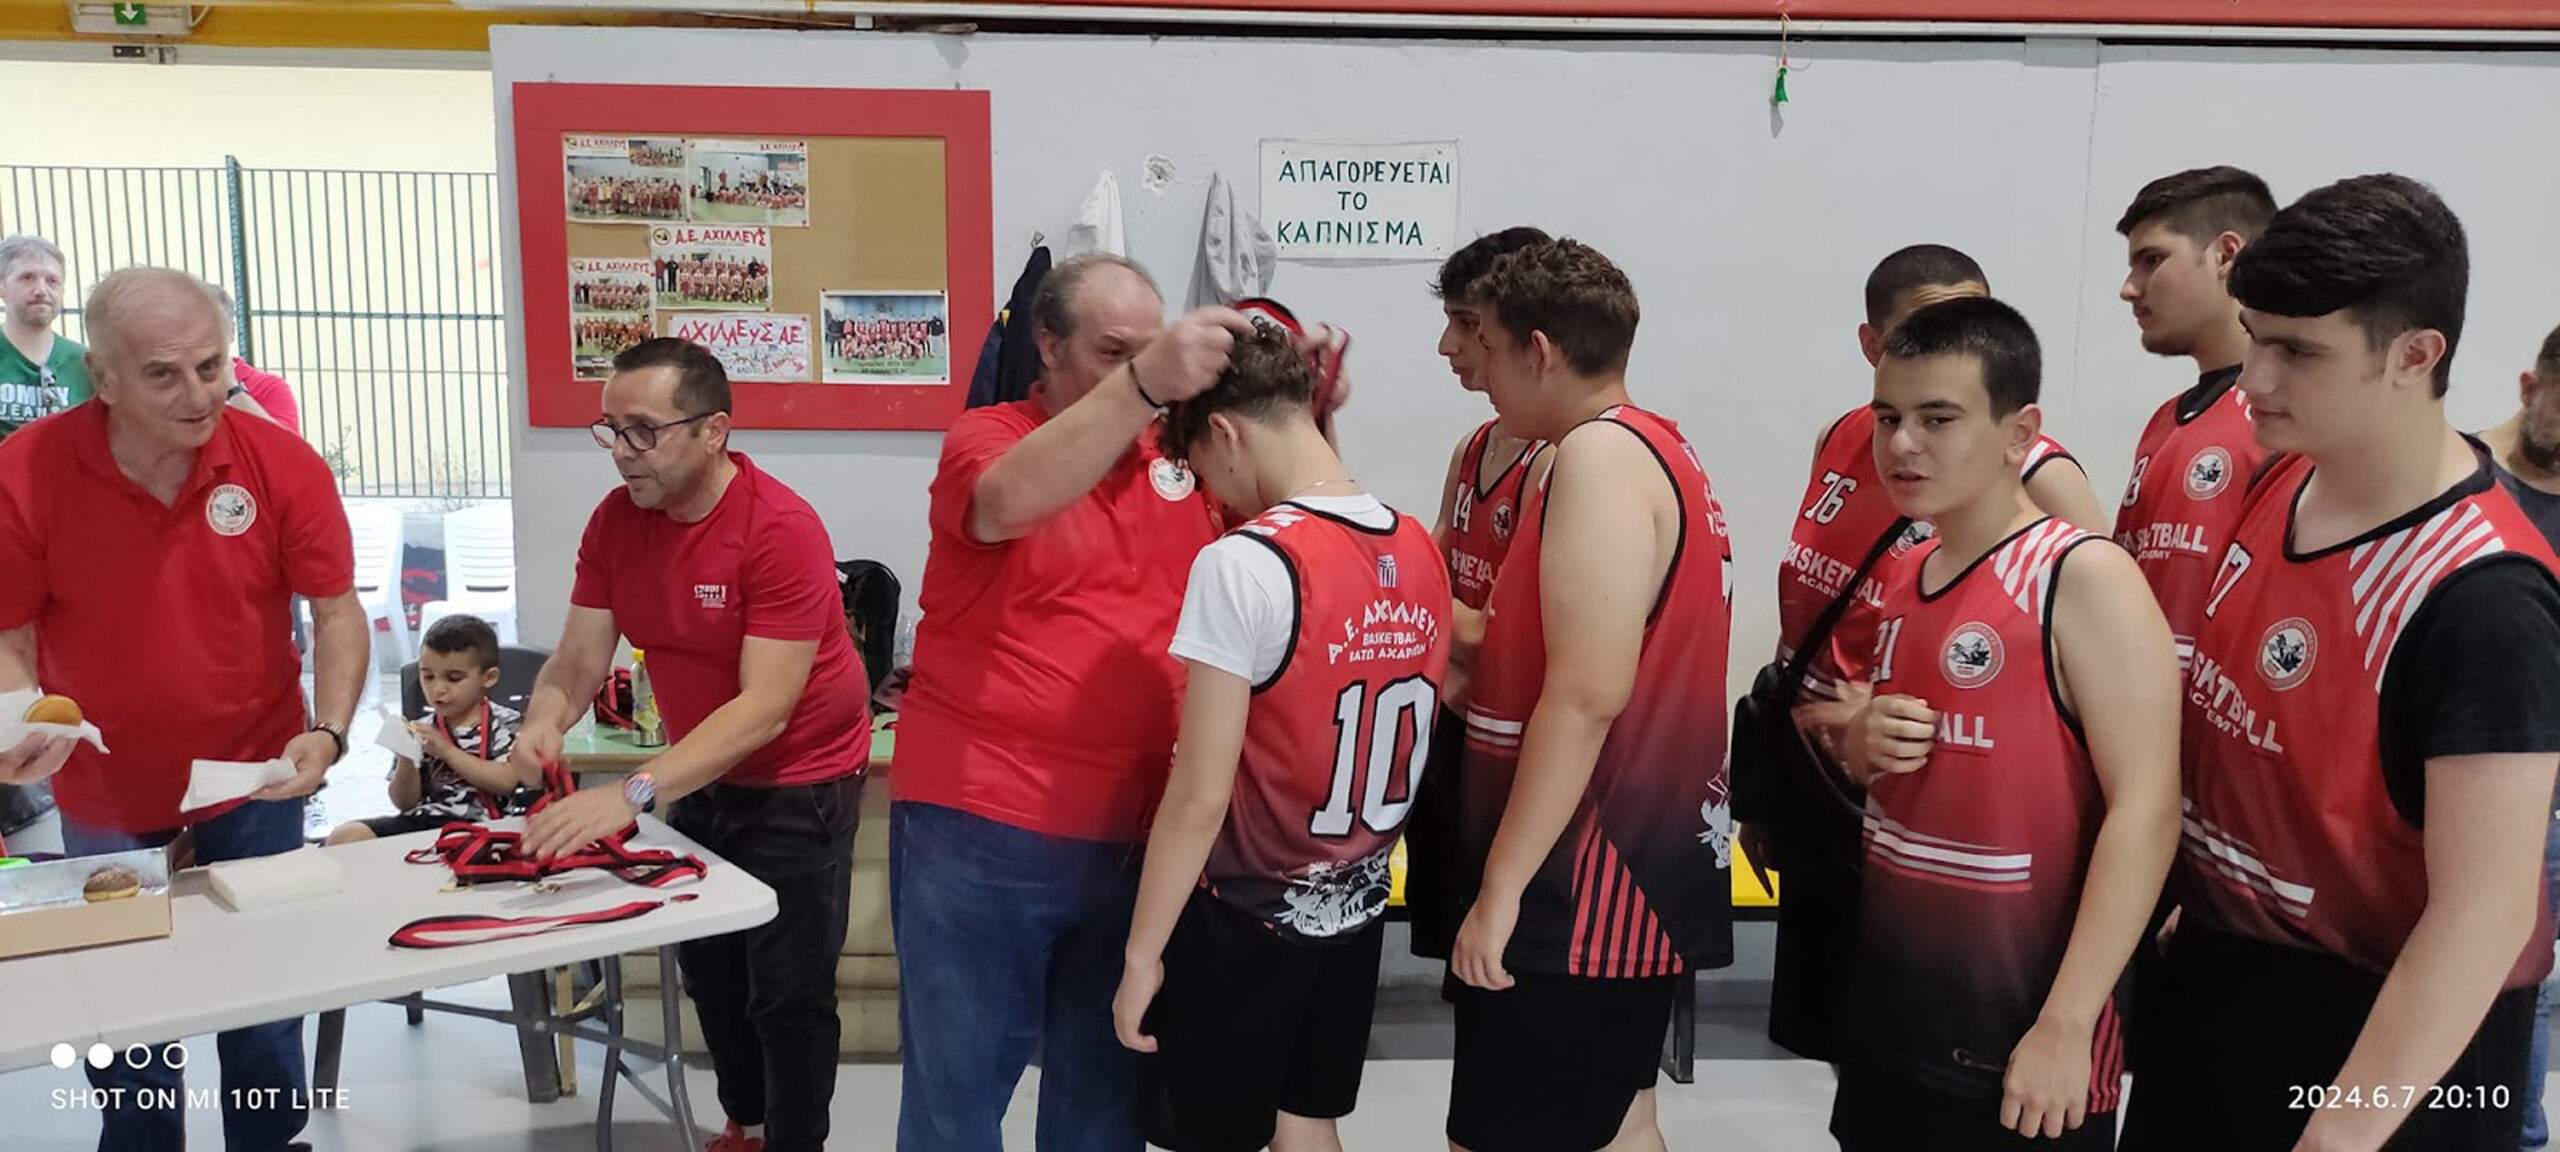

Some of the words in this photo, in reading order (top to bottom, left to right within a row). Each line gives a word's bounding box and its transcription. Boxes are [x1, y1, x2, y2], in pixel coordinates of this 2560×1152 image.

[1278, 159, 1451, 184] ΑΠΑΓΟΡΕΥΕΤΑΙ
[1337, 190, 1368, 211] ΤΟ
[1277, 220, 1424, 246] ΚΑΠΝΙΣΜΑ
[1, 383, 70, 406] OMY
[1804, 470, 1858, 525] 76
[1310, 672, 1436, 837] 10
